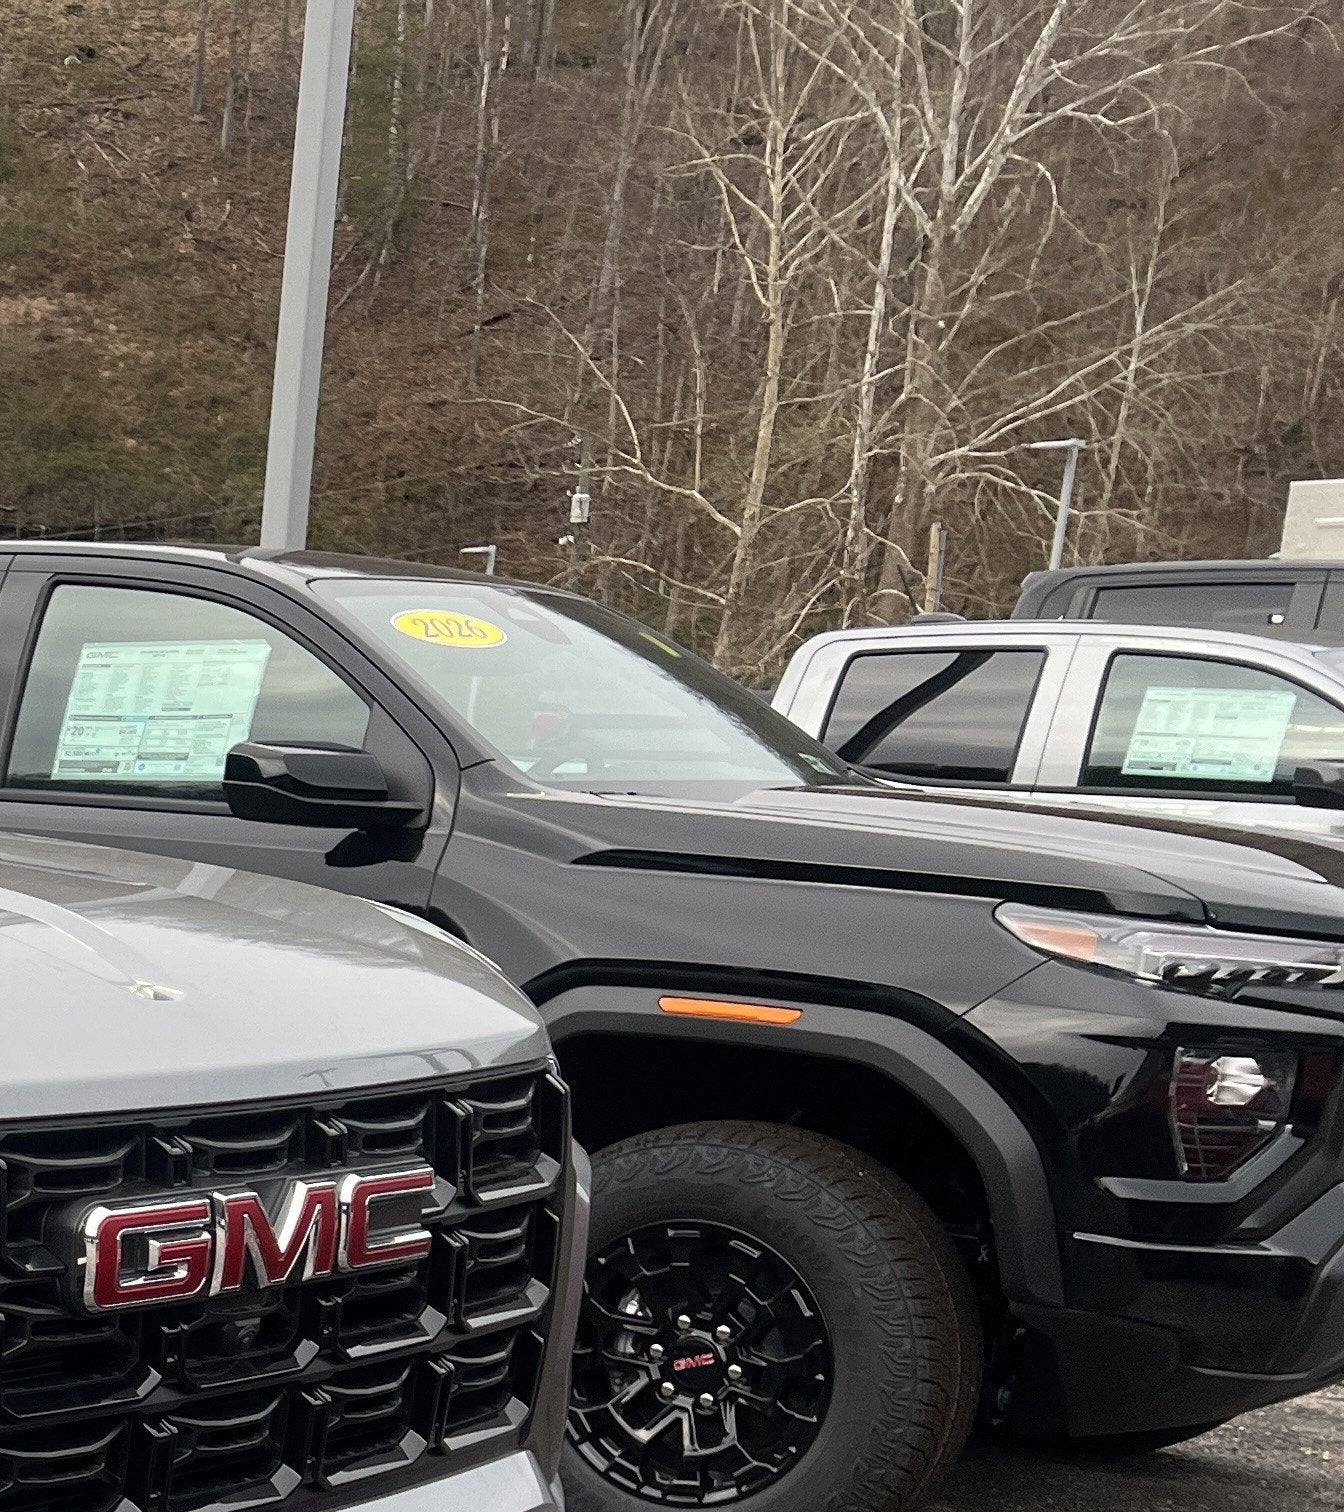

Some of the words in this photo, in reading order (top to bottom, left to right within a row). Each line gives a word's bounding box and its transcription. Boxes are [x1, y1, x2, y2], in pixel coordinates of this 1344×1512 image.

[412, 618, 488, 640] 2026
[85, 651, 120, 659] GMC
[83, 1166, 436, 1312] GMC
[673, 1352, 715, 1371] GMC
